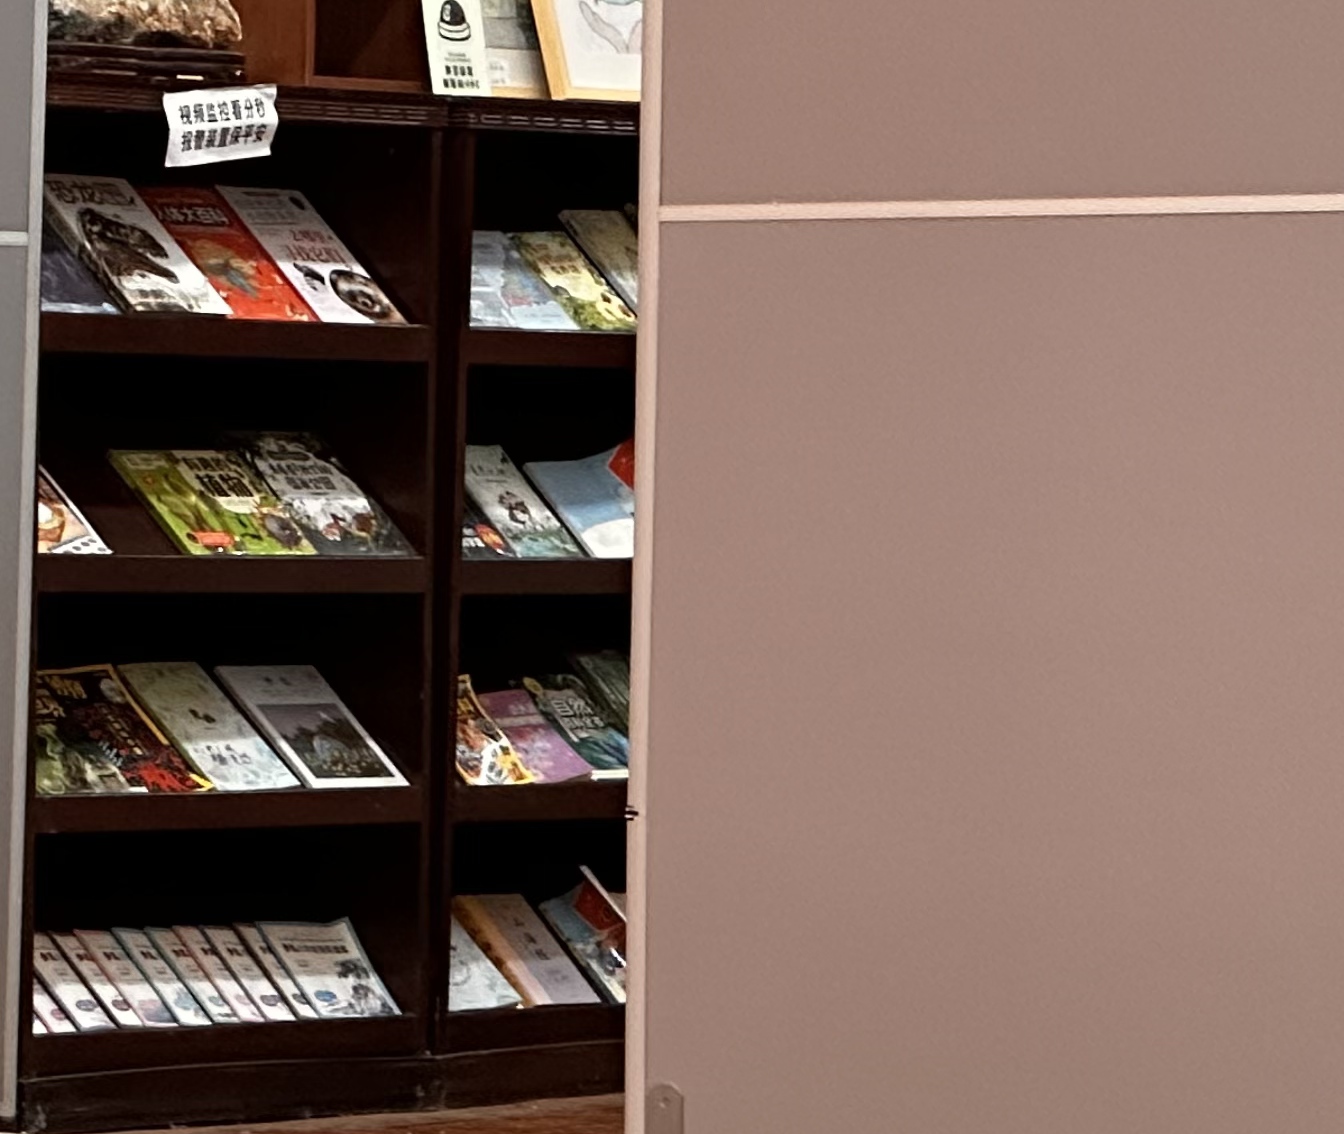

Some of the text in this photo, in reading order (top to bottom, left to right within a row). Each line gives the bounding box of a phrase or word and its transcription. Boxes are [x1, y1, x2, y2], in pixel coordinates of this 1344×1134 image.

[178, 97, 266, 125] 视频监控看分秒
[181, 123, 267, 152] 报警装置保平安
[194, 473, 255, 497] 植物
